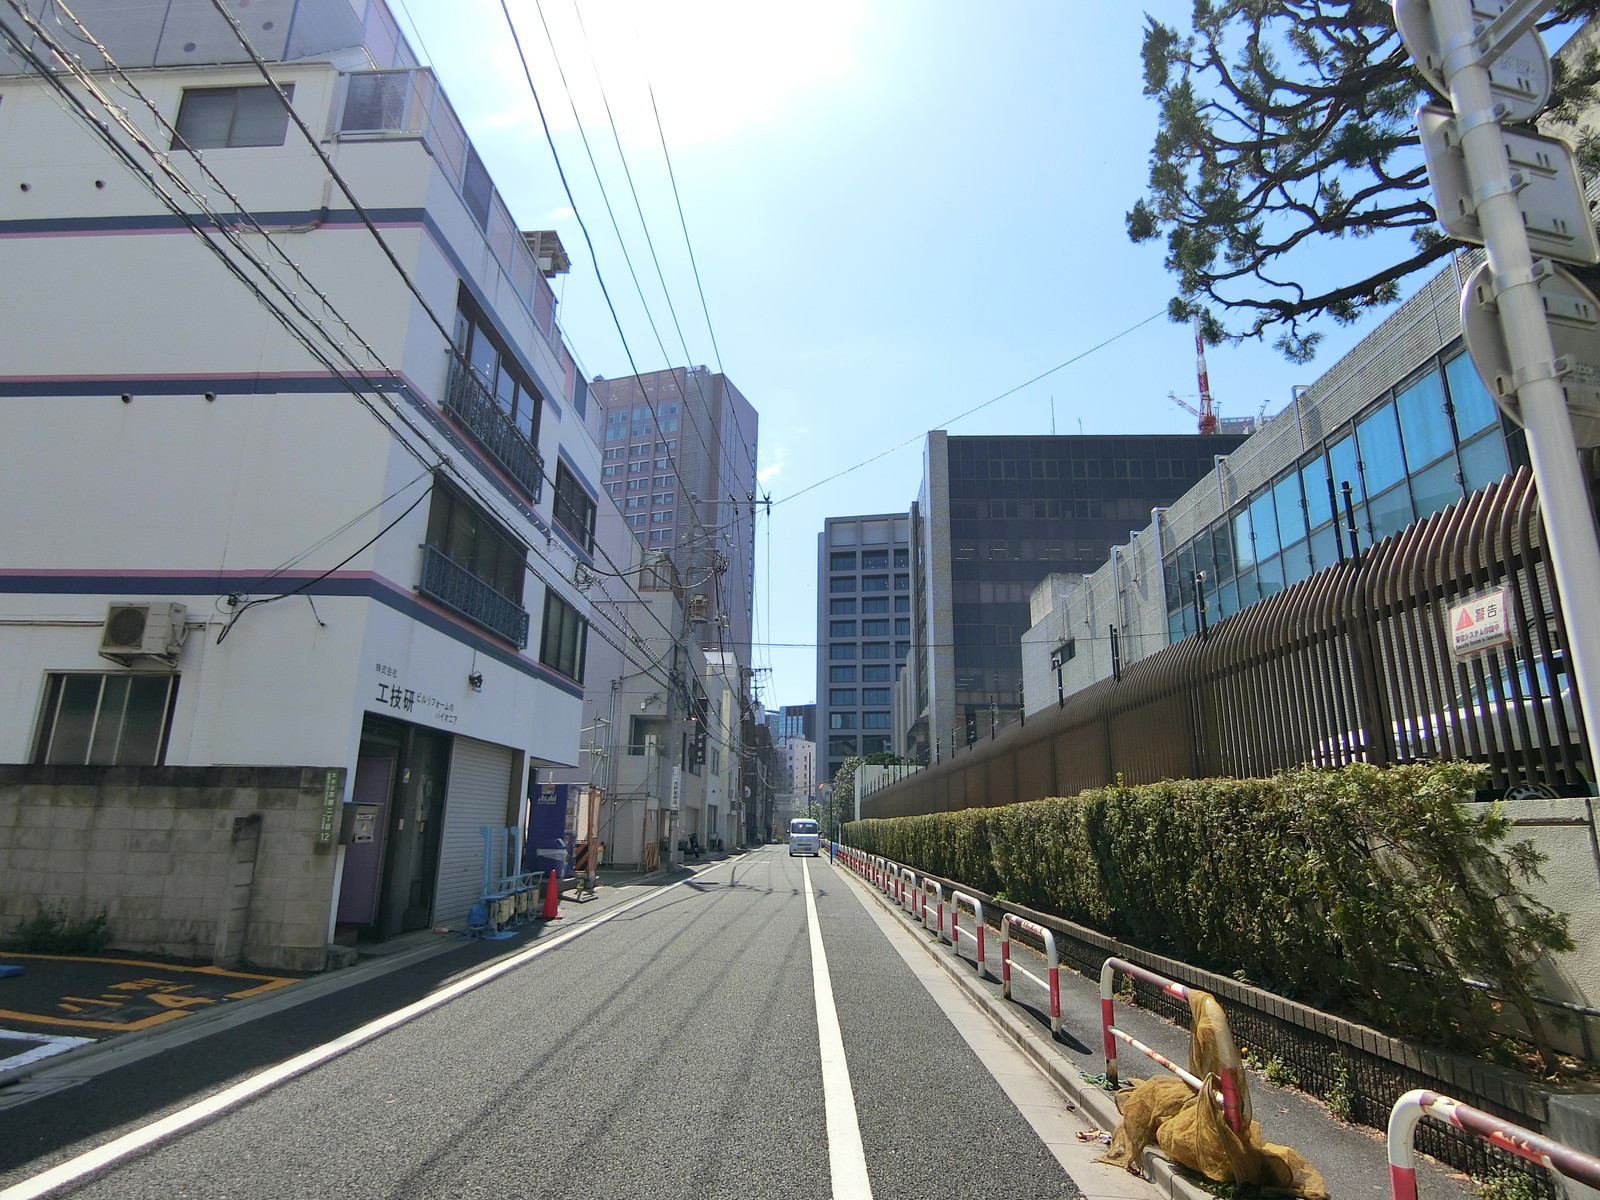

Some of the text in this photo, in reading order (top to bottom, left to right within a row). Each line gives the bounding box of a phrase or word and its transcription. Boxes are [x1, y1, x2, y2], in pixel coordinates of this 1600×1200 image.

[1475, 603, 1498, 622] 警告
[376, 662, 398, 678] 株式会社
[375, 682, 415, 713] 工技研
[320, 832, 330, 841] 12
[146, 992, 217, 1009] 4
